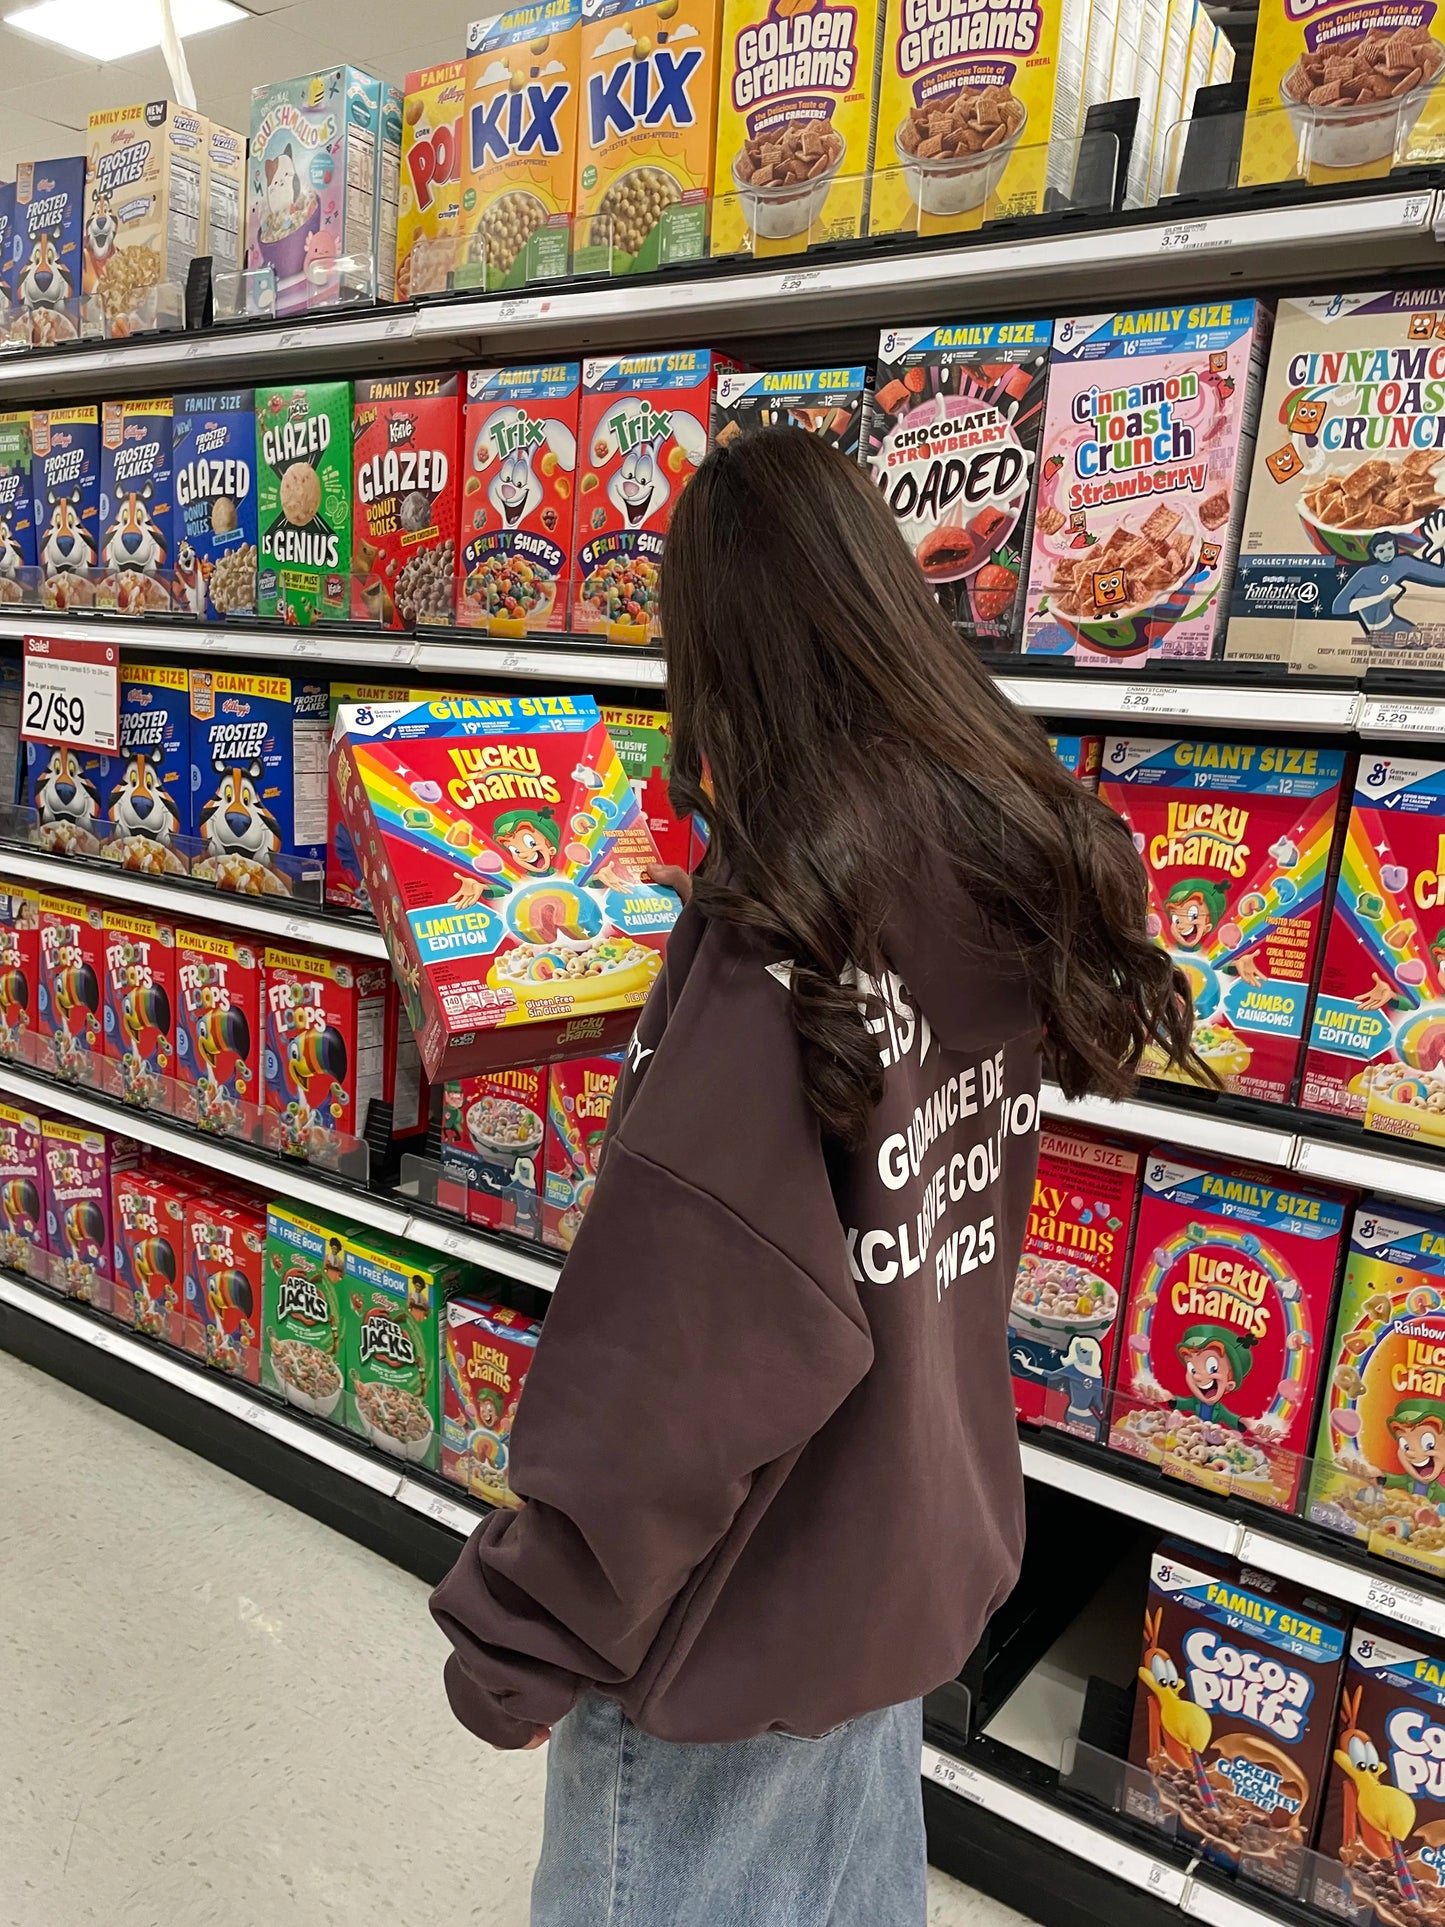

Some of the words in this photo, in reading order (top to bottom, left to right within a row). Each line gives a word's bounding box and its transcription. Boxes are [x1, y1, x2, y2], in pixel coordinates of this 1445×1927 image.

[1317, 19, 1332, 32] the
[1335, 8, 1380, 26] Delicious
[1382, 4, 1408, 17] Taste
[1410, 3, 1424, 15] of
[1025, 57, 1051, 67] CEREAL
[922, 78, 935, 88] the
[937, 69, 969, 85] Delicious
[972, 66, 991, 76] Taste
[995, 65, 1006, 74] of
[146, 103, 164, 117] NEW
[589, 51, 702, 146] KIX
[754, 110, 768, 120] the
[769, 103, 795, 117] Delicious
[797, 101, 815, 111] Taste
[818, 101, 827, 109] of
[89, 109, 119, 127] FAMILY
[121, 107, 142, 121] SIZE
[472, 86, 568, 169] KIX
[253, 106, 336, 158] SQUISHMALLOWS
[98, 141, 150, 176] FROSTED
[100, 162, 145, 193] FLAKES
[26, 193, 67, 220] FROSTED
[28, 209, 63, 233] FLAKES
[1162, 234, 1189, 246] 3.79
[780, 280, 801, 290] 5.29
[1113, 310, 1184, 336] FAMILY
[1187, 305, 1233, 329] SIZE
[934, 327, 994, 346] FAMILY
[998, 325, 1035, 343] SIZE
[499, 370, 538, 386] FAMILY
[541, 367, 566, 382] SIZE
[619, 357, 662, 375] FAMILY
[667, 354, 696, 372] SIZE
[370, 380, 410, 399] FAMILY
[414, 379, 440, 396] SIZE
[764, 373, 814, 391] FAMILY
[818, 371, 849, 388] SIZE
[125, 400, 152, 411] FAMILY
[154, 398, 174, 410] SIZE
[185, 396, 215, 412] FAMILY
[220, 395, 241, 410] SIZE
[1076, 374, 1197, 420] Cinnamon
[51, 409, 75, 421] FAMILY
[78, 406, 94, 417] SIZE
[1097, 402, 1171, 443] Toast
[263, 413, 331, 466] GLAZED
[491, 410, 545, 459] Trix
[609, 402, 672, 454] Trix
[895, 411, 997, 448] CHOCOLATE
[44, 449, 84, 474] FROSTED
[114, 442, 160, 467] FROSTED
[1078, 427, 1193, 475] Crunch
[46, 464, 81, 487] FLAKES
[115, 458, 154, 481] FLAKES
[358, 449, 449, 503] GLAZED
[177, 459, 250, 506] GLAZED
[1071, 463, 1207, 509] Strawberry
[184, 501, 208, 522] DONUT
[366, 497, 397, 521] DONUT
[370, 516, 397, 537] HOLES
[262, 534, 272, 555] IS
[273, 530, 339, 568] GENIUS
[1252, 558, 1287, 566] COLLECT
[1288, 558, 1311, 566] THEM
[1312, 558, 1327, 566] ALL
[29, 639, 49, 653] Sale!
[122, 668, 154, 683] GIANT
[160, 671, 184, 685] SIZE
[216, 675, 254, 692] GIANT
[258, 680, 287, 696] SIZE
[357, 688, 386, 699] GIANT
[388, 690, 409, 702] SIZE
[1123, 696, 1149, 705] 5.29
[26, 692, 84, 735] 2/$9
[429, 697, 514, 720] GIANT
[522, 697, 578, 716] SIZE
[1376, 713, 1407, 723] 5.29
[208, 722, 268, 743] FROSTED
[548, 719, 562, 731] 12
[212, 740, 262, 759] FLAKES
[627, 751, 647, 762] ITEM
[1174, 743, 1256, 771] GIANT
[1259, 749, 1318, 776] SIZE
[448, 745, 542, 780] Lucky
[1389, 769, 1418, 777] General
[1388, 774, 1405, 782] Mills
[448, 775, 560, 809] Charms
[1168, 802, 1249, 845] Lucky
[1150, 834, 1250, 878] Charms
[622, 898, 672, 914] JUMBO
[415, 913, 490, 939] LIMITED
[1266, 916, 1288, 926] FROSTED
[1288, 918, 1311, 929] TOASTED
[1277, 926, 1295, 937] CEREAL
[1296, 929, 1310, 938] WITH
[41, 924, 81, 951] FROOT
[429, 930, 487, 951] EDITION
[45, 947, 83, 970] LOOPS
[106, 942, 150, 970] FROOT
[1266, 947, 1284, 957] CEREAL
[1285, 949, 1306, 960] TOSTADO
[1269, 956, 1293, 968] GLASEADO
[1294, 960, 1305, 970] CON
[111, 966, 153, 990] LOOPS
[179, 962, 228, 991] FROOT
[185, 986, 230, 1012] LOOPS
[268, 980, 324, 1012] FROOT
[526, 998, 554, 1009] Gluten
[555, 996, 574, 1005] Free
[1240, 991, 1294, 1014] JUMBO
[275, 1006, 327, 1034] LOOPS
[528, 1007, 543, 1018] Sin
[544, 1004, 571, 1016] Gluten
[1236, 1008, 1294, 1027] RAINBOWS!
[1315, 1008, 1382, 1036] LIMITED
[179, 1034, 184, 1045] 9
[1318, 1027, 1371, 1050] EDITION
[268, 1057, 273, 1068] 9
[981, 1050, 1004, 1108] DE
[1202, 1177, 1273, 1208] FAMILY
[1276, 1196, 1321, 1221] SIZE
[191, 1223, 233, 1247] FROOT
[280, 1228, 283, 1236] 1
[285, 1230, 301, 1245] FREE
[302, 1237, 322, 1254] BOOK
[196, 1242, 234, 1267] LOOPS
[936, 1216, 995, 1303] FW25
[287, 1277, 316, 1296] APPLE
[1189, 1253, 1268, 1306] Lucky
[279, 1286, 327, 1320] JACKS
[1171, 1283, 1271, 1338] Charms
[369, 1316, 400, 1336] APPLE
[361, 1326, 414, 1363] JACKS
[472, 1341, 509, 1373] Lucky
[467, 1358, 511, 1394] Charms
[1368, 1590, 1396, 1608] 5.29
[1207, 1584, 1277, 1625] FAMILY
[1279, 1615, 1322, 1645] SIZE
[1187, 1632, 1309, 1707] Cocoa
[935, 1764, 955, 1780] 6.19
[1234, 1757, 1282, 1788] GREAT
[1218, 1760, 1299, 1814] CHOCOLATEY
